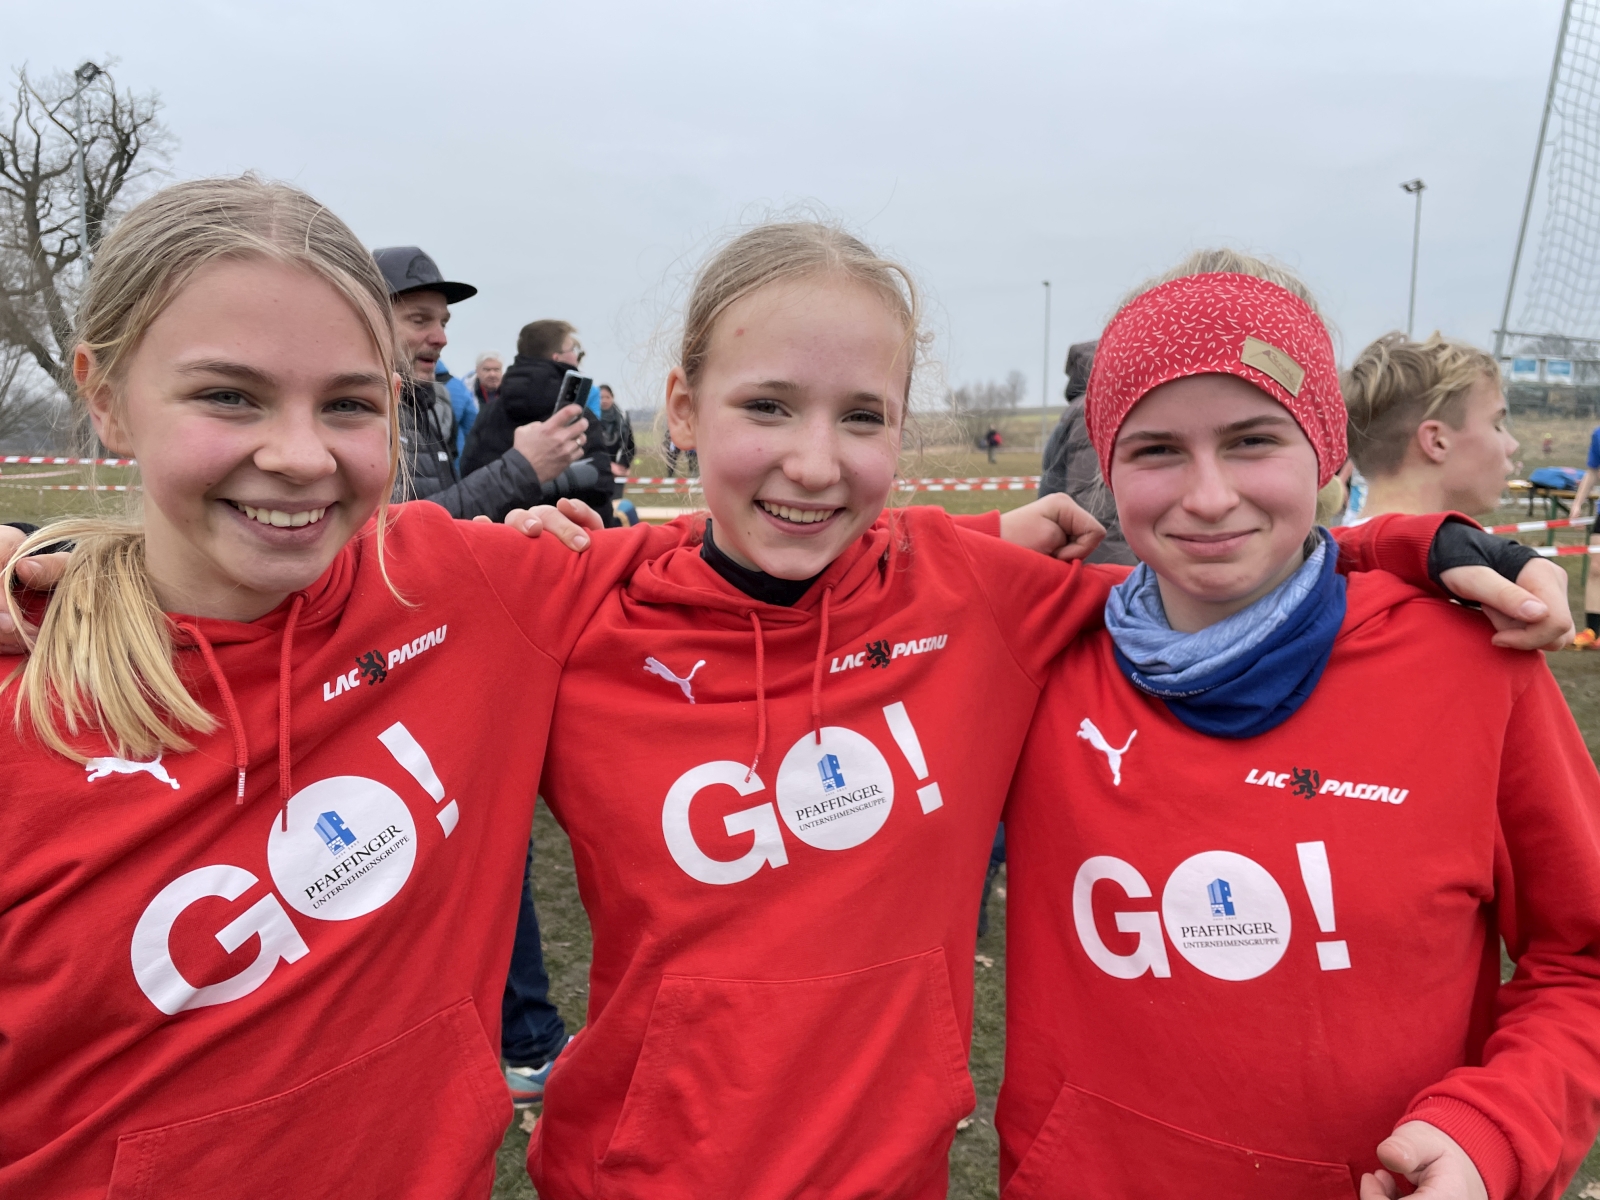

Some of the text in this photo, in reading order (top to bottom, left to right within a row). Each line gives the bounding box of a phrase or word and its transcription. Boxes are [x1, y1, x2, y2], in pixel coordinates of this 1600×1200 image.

[323, 624, 448, 701] LAC PASSAU
[829, 634, 948, 673] LAC PASSAU
[795, 783, 883, 822] PFAFFINGER
[1245, 768, 1409, 805] LAC PASSAU
[799, 796, 887, 832] UNTERNEHMENSGRUPPE
[303, 823, 404, 901] PFAFFINGER
[312, 834, 411, 910] UNTERNEHMENSGRUPPE
[1180, 921, 1278, 939] PFAFFINGER
[1183, 937, 1281, 950] UNTERNEHMENSGRUPPE
